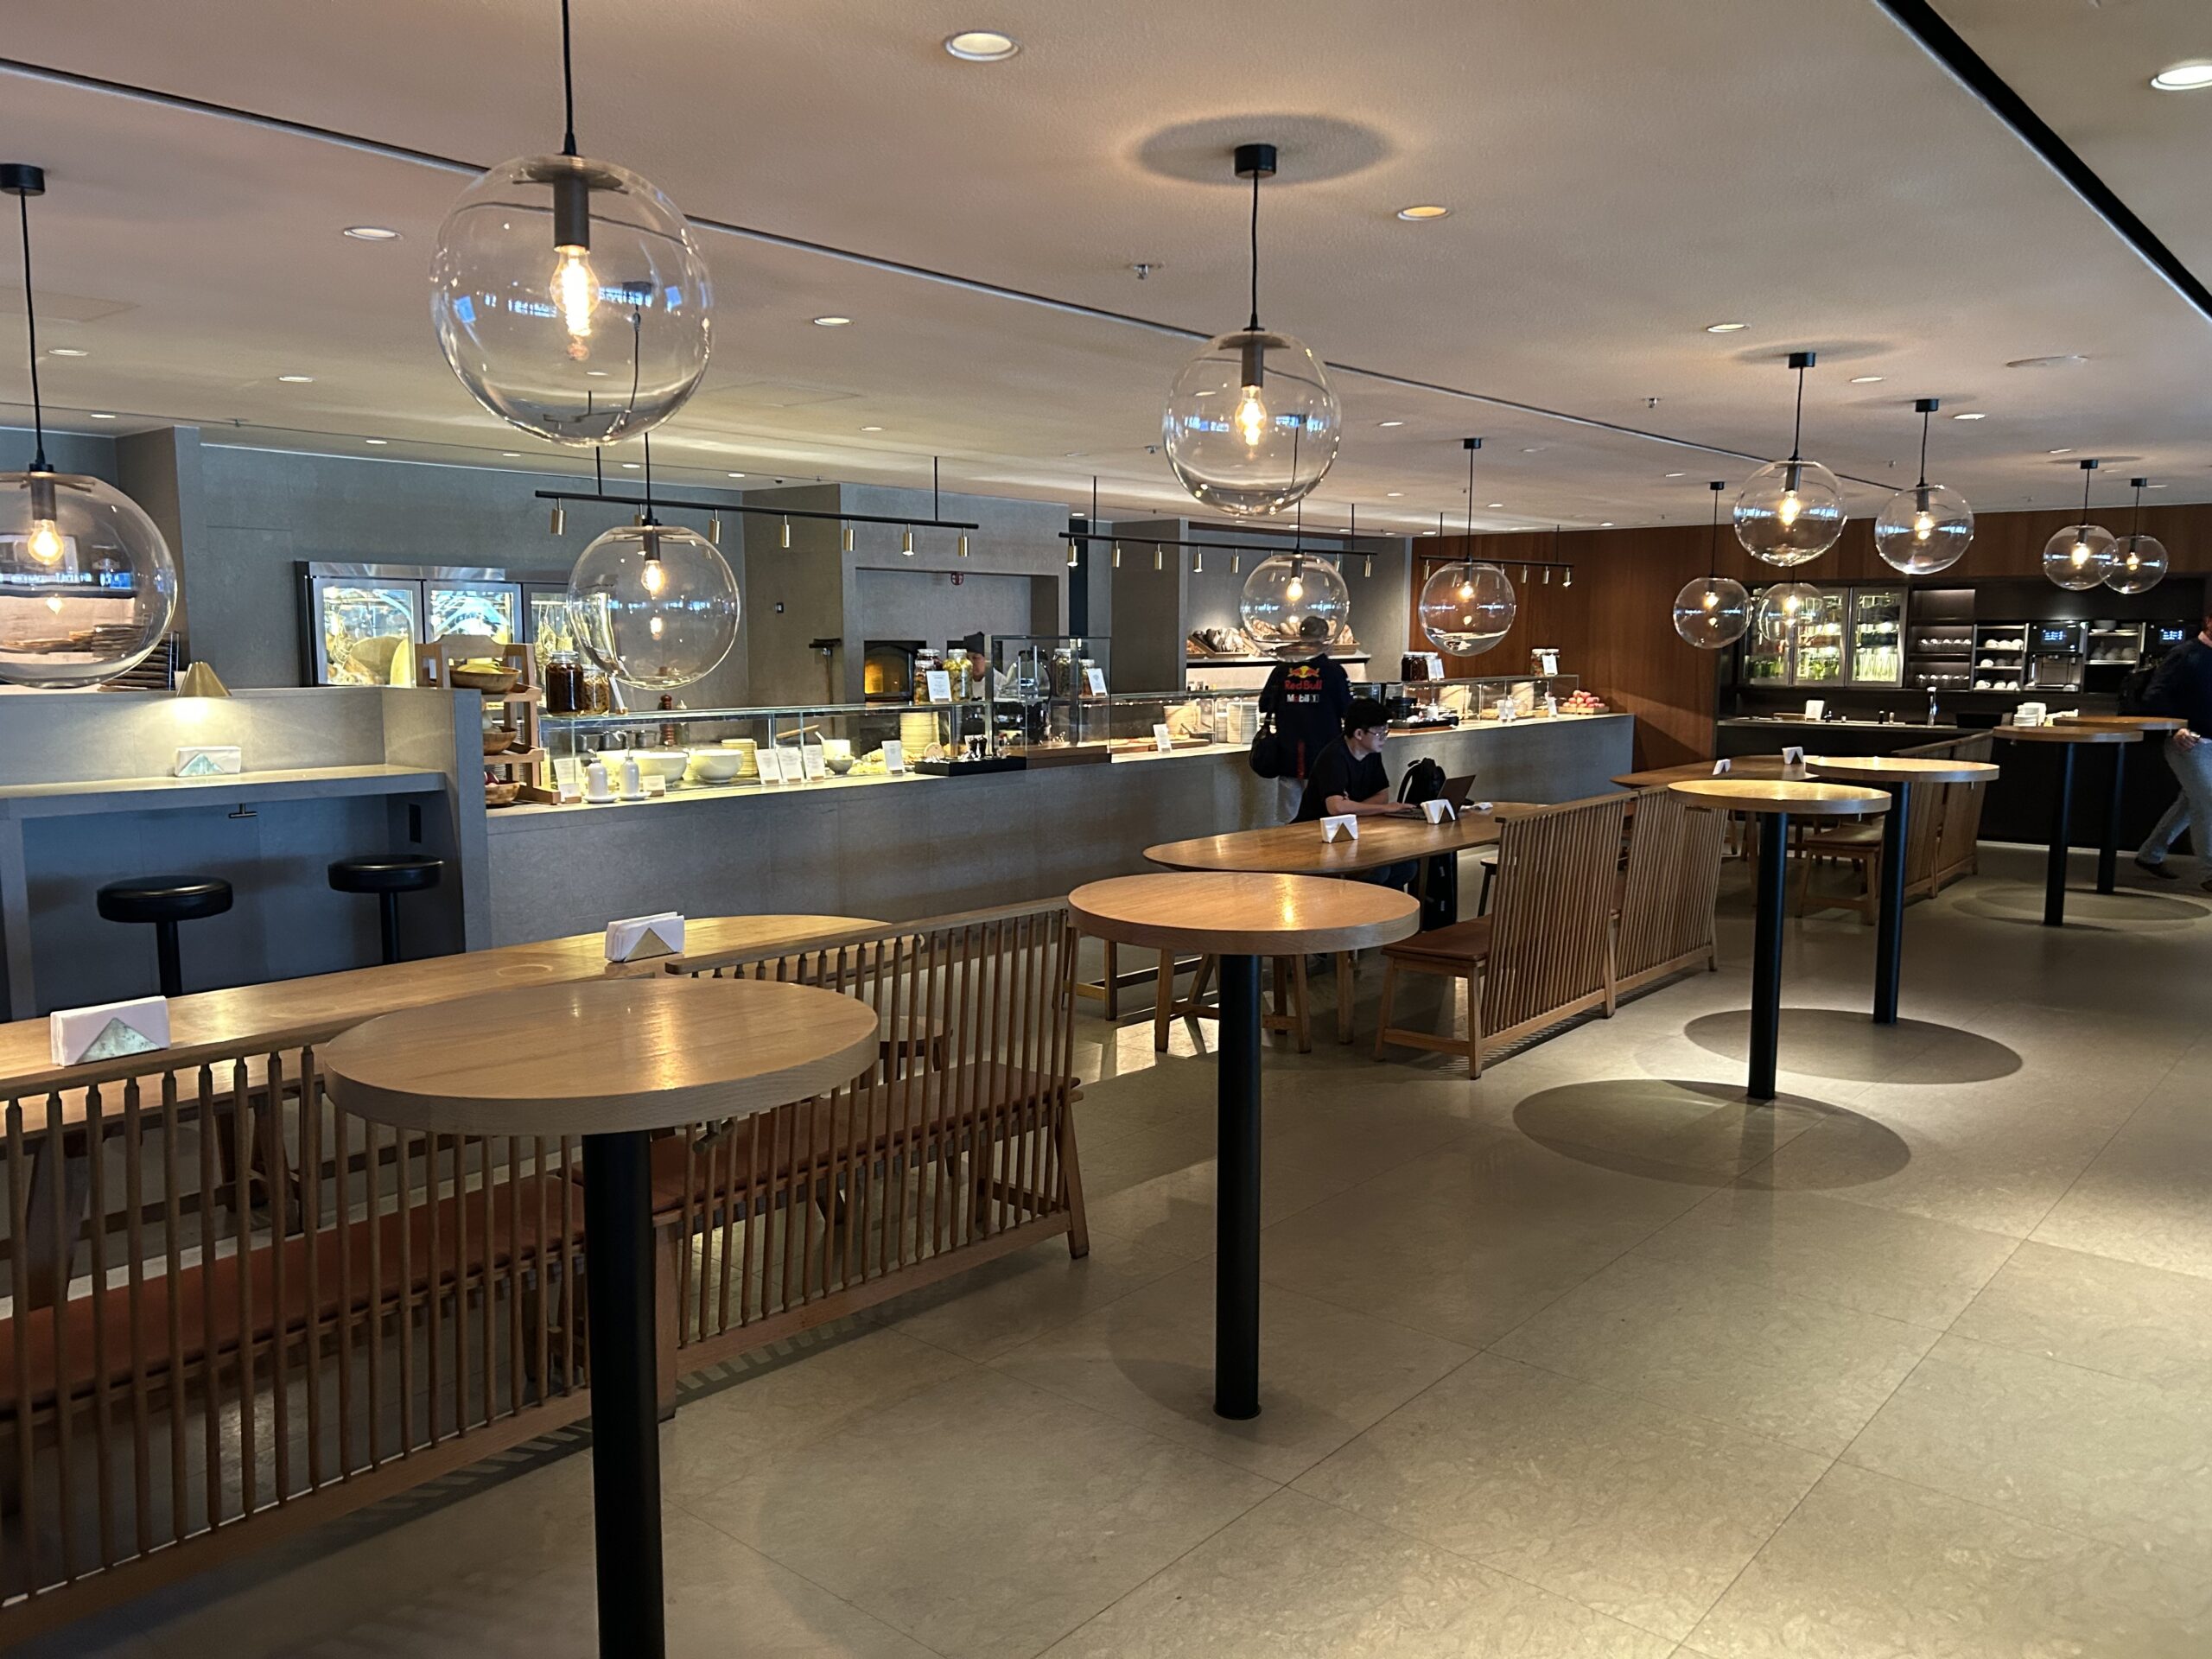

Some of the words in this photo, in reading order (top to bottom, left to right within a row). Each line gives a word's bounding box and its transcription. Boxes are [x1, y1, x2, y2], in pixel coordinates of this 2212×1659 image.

[1285, 680, 1301, 690] Red
[1303, 679, 1322, 690] Bull
[1287, 694, 1310, 702] Mobil
